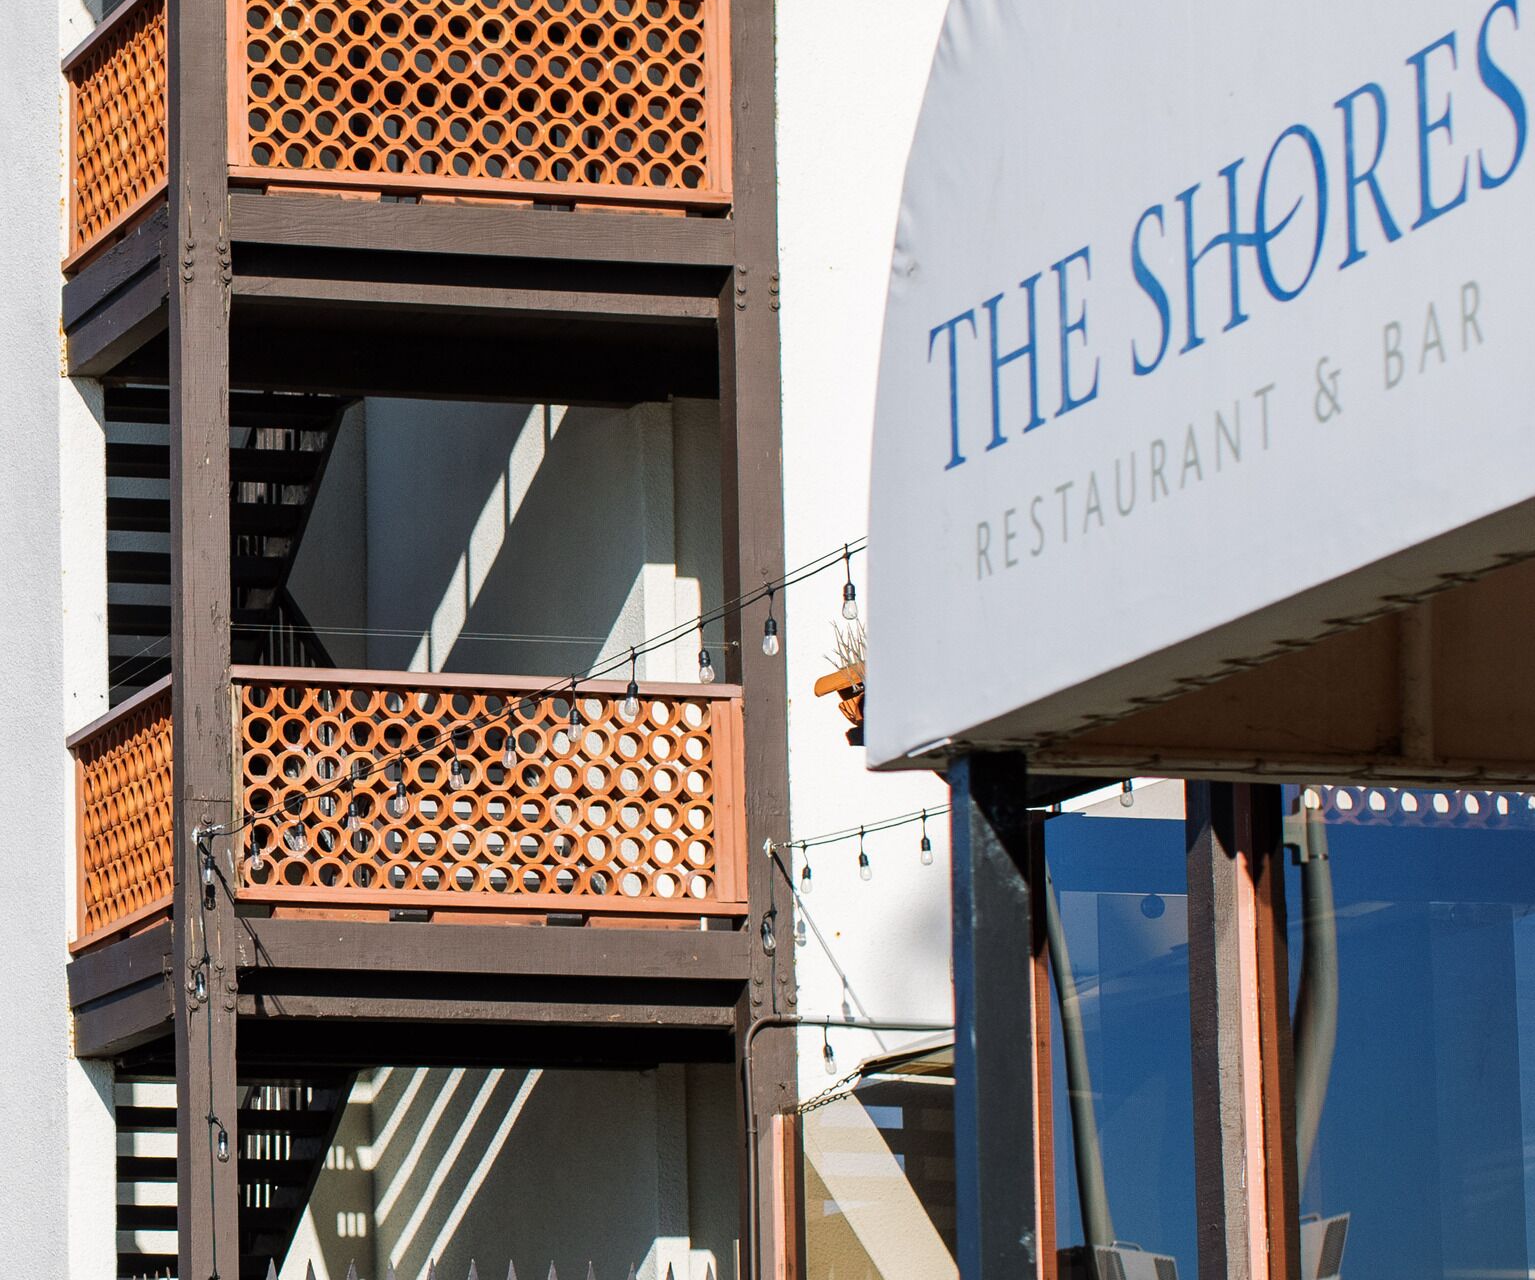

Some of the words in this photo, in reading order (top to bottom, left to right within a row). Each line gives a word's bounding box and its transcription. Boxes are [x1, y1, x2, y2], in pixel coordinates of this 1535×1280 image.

[928, 245, 1101, 472] THE
[976, 382, 1277, 581] RESTAURANT
[1313, 355, 1344, 424] &
[1383, 279, 1485, 391] BAR
